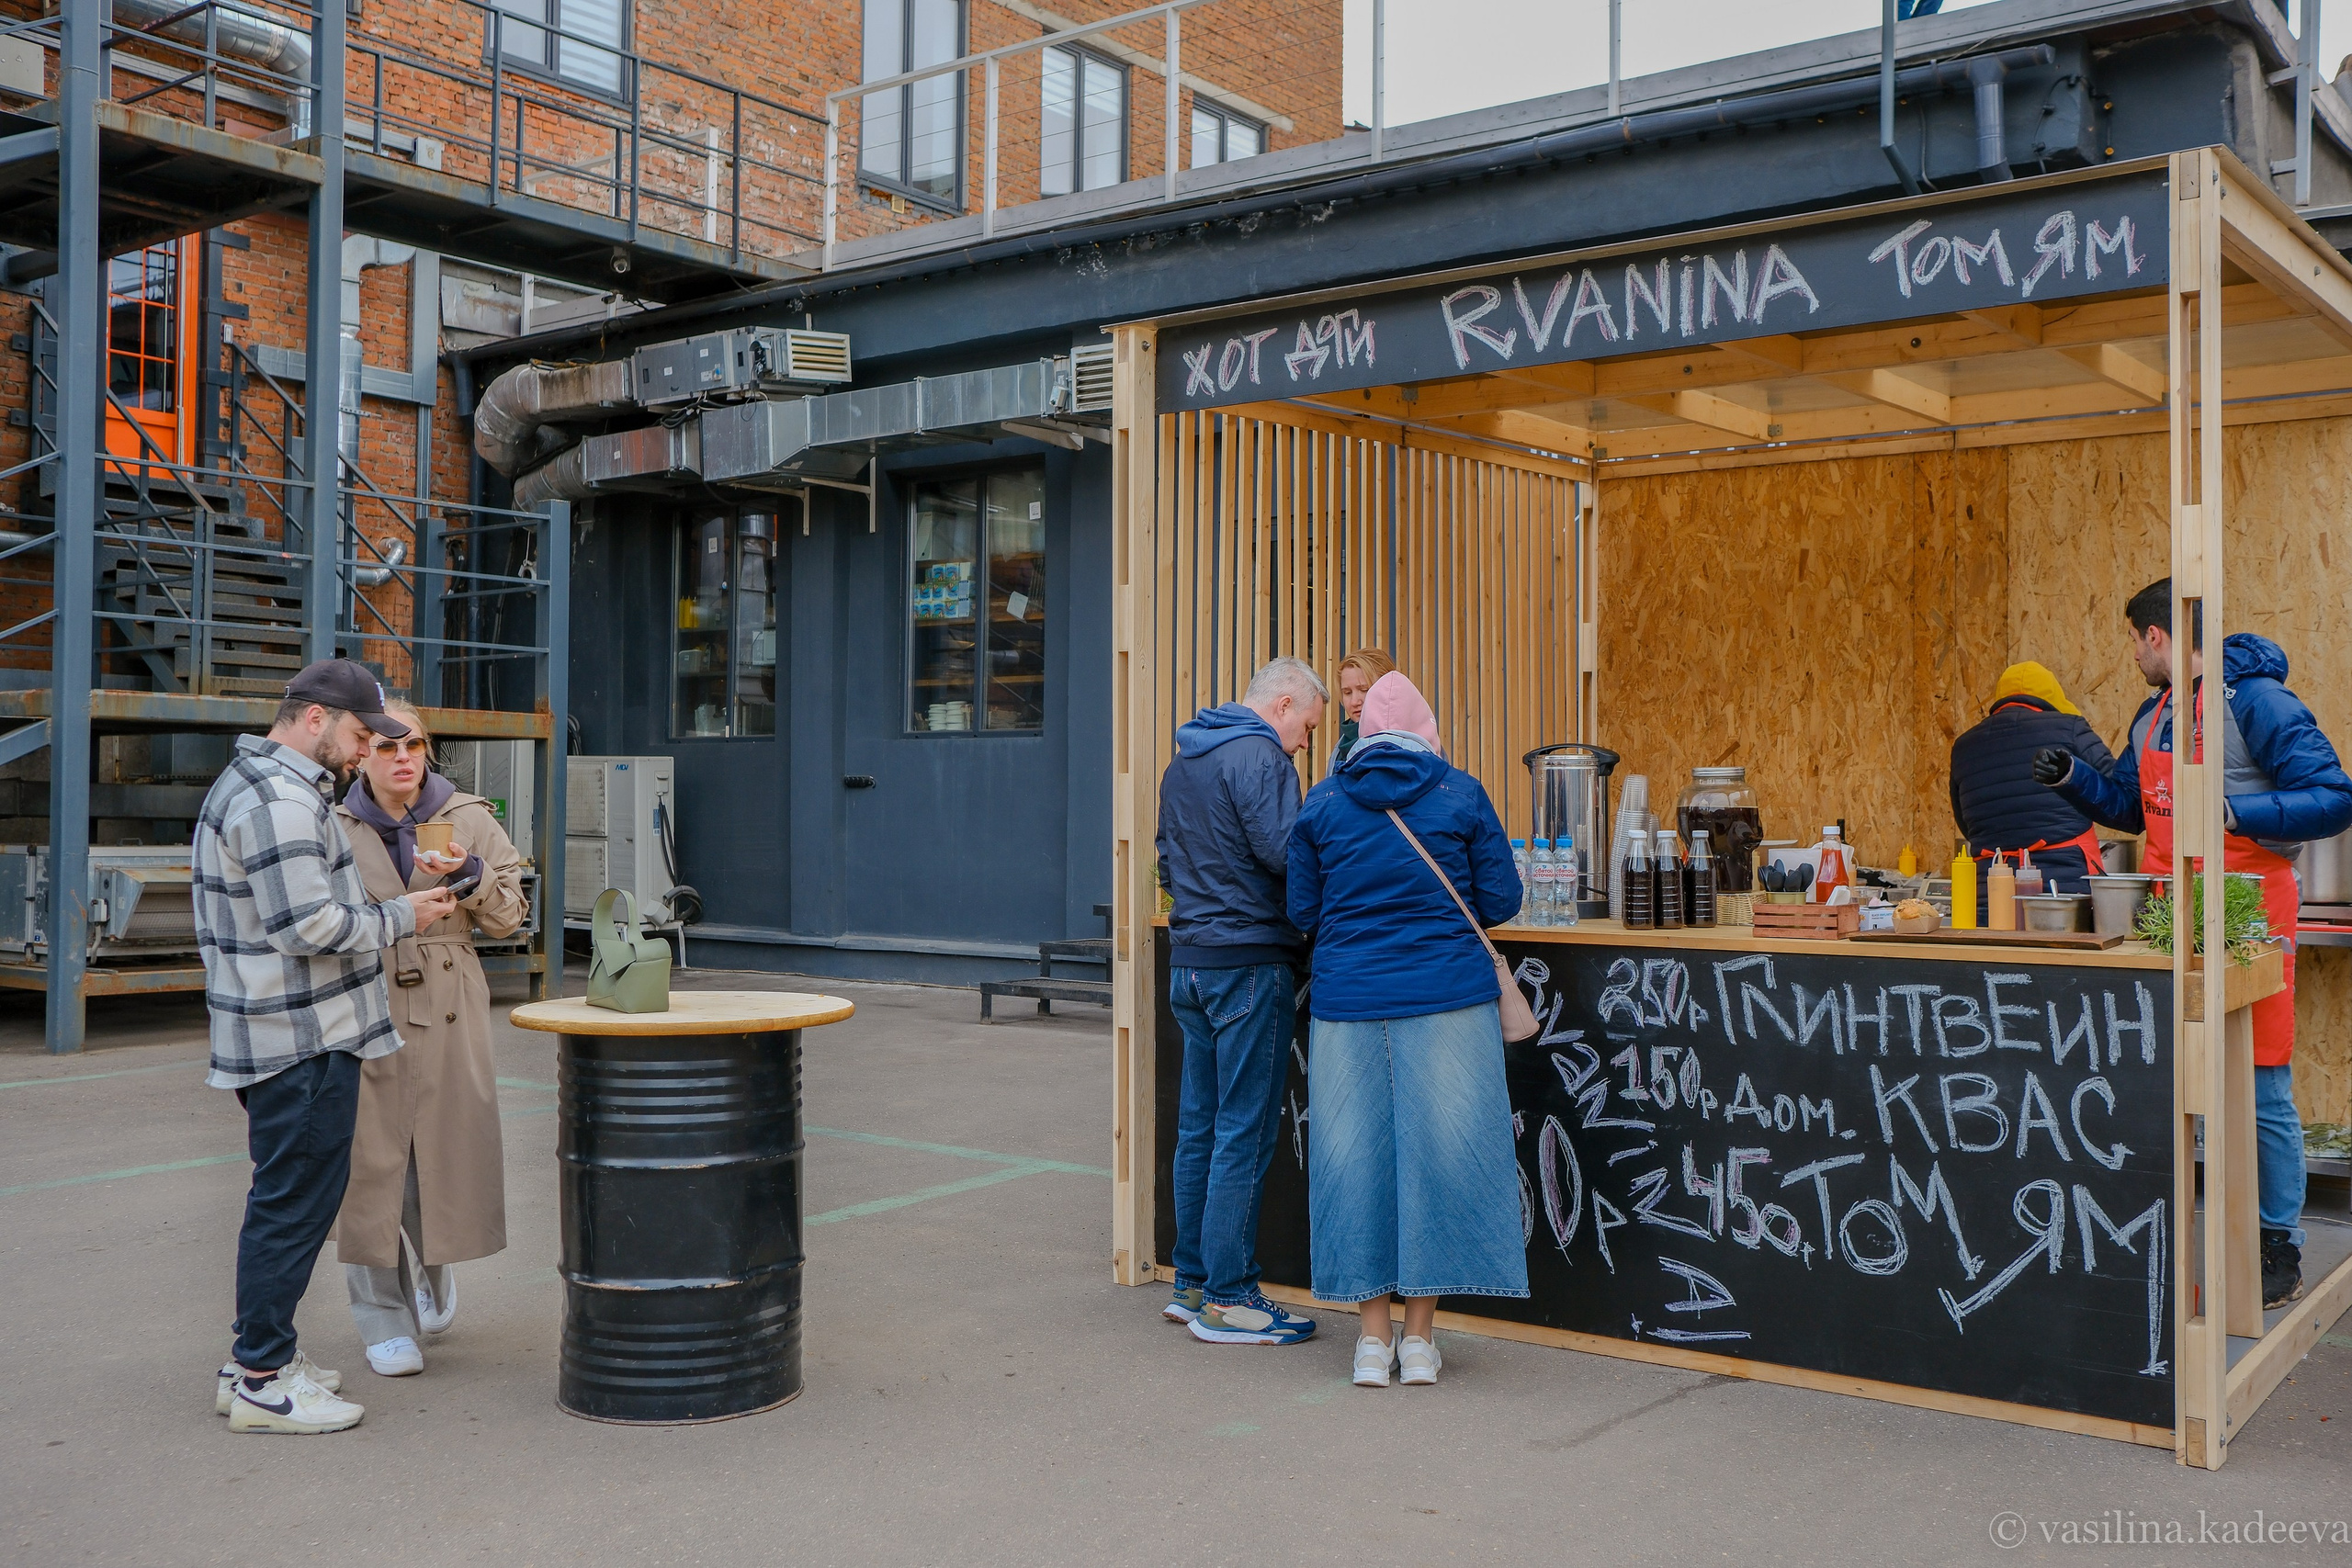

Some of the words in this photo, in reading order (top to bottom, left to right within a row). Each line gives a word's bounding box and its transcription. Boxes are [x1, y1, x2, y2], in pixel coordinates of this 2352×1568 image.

[1869, 219, 2017, 299] ТОМ
[2022, 209, 2142, 298] ЯМ
[1183, 325, 1278, 399] ХОТ
[2144, 800, 2173, 818] Rvan
[1869, 1064, 2136, 1170] КВАС
[1780, 1152, 1983, 1280] ТОМ
[1938, 1179, 2169, 1376] ЯМ
